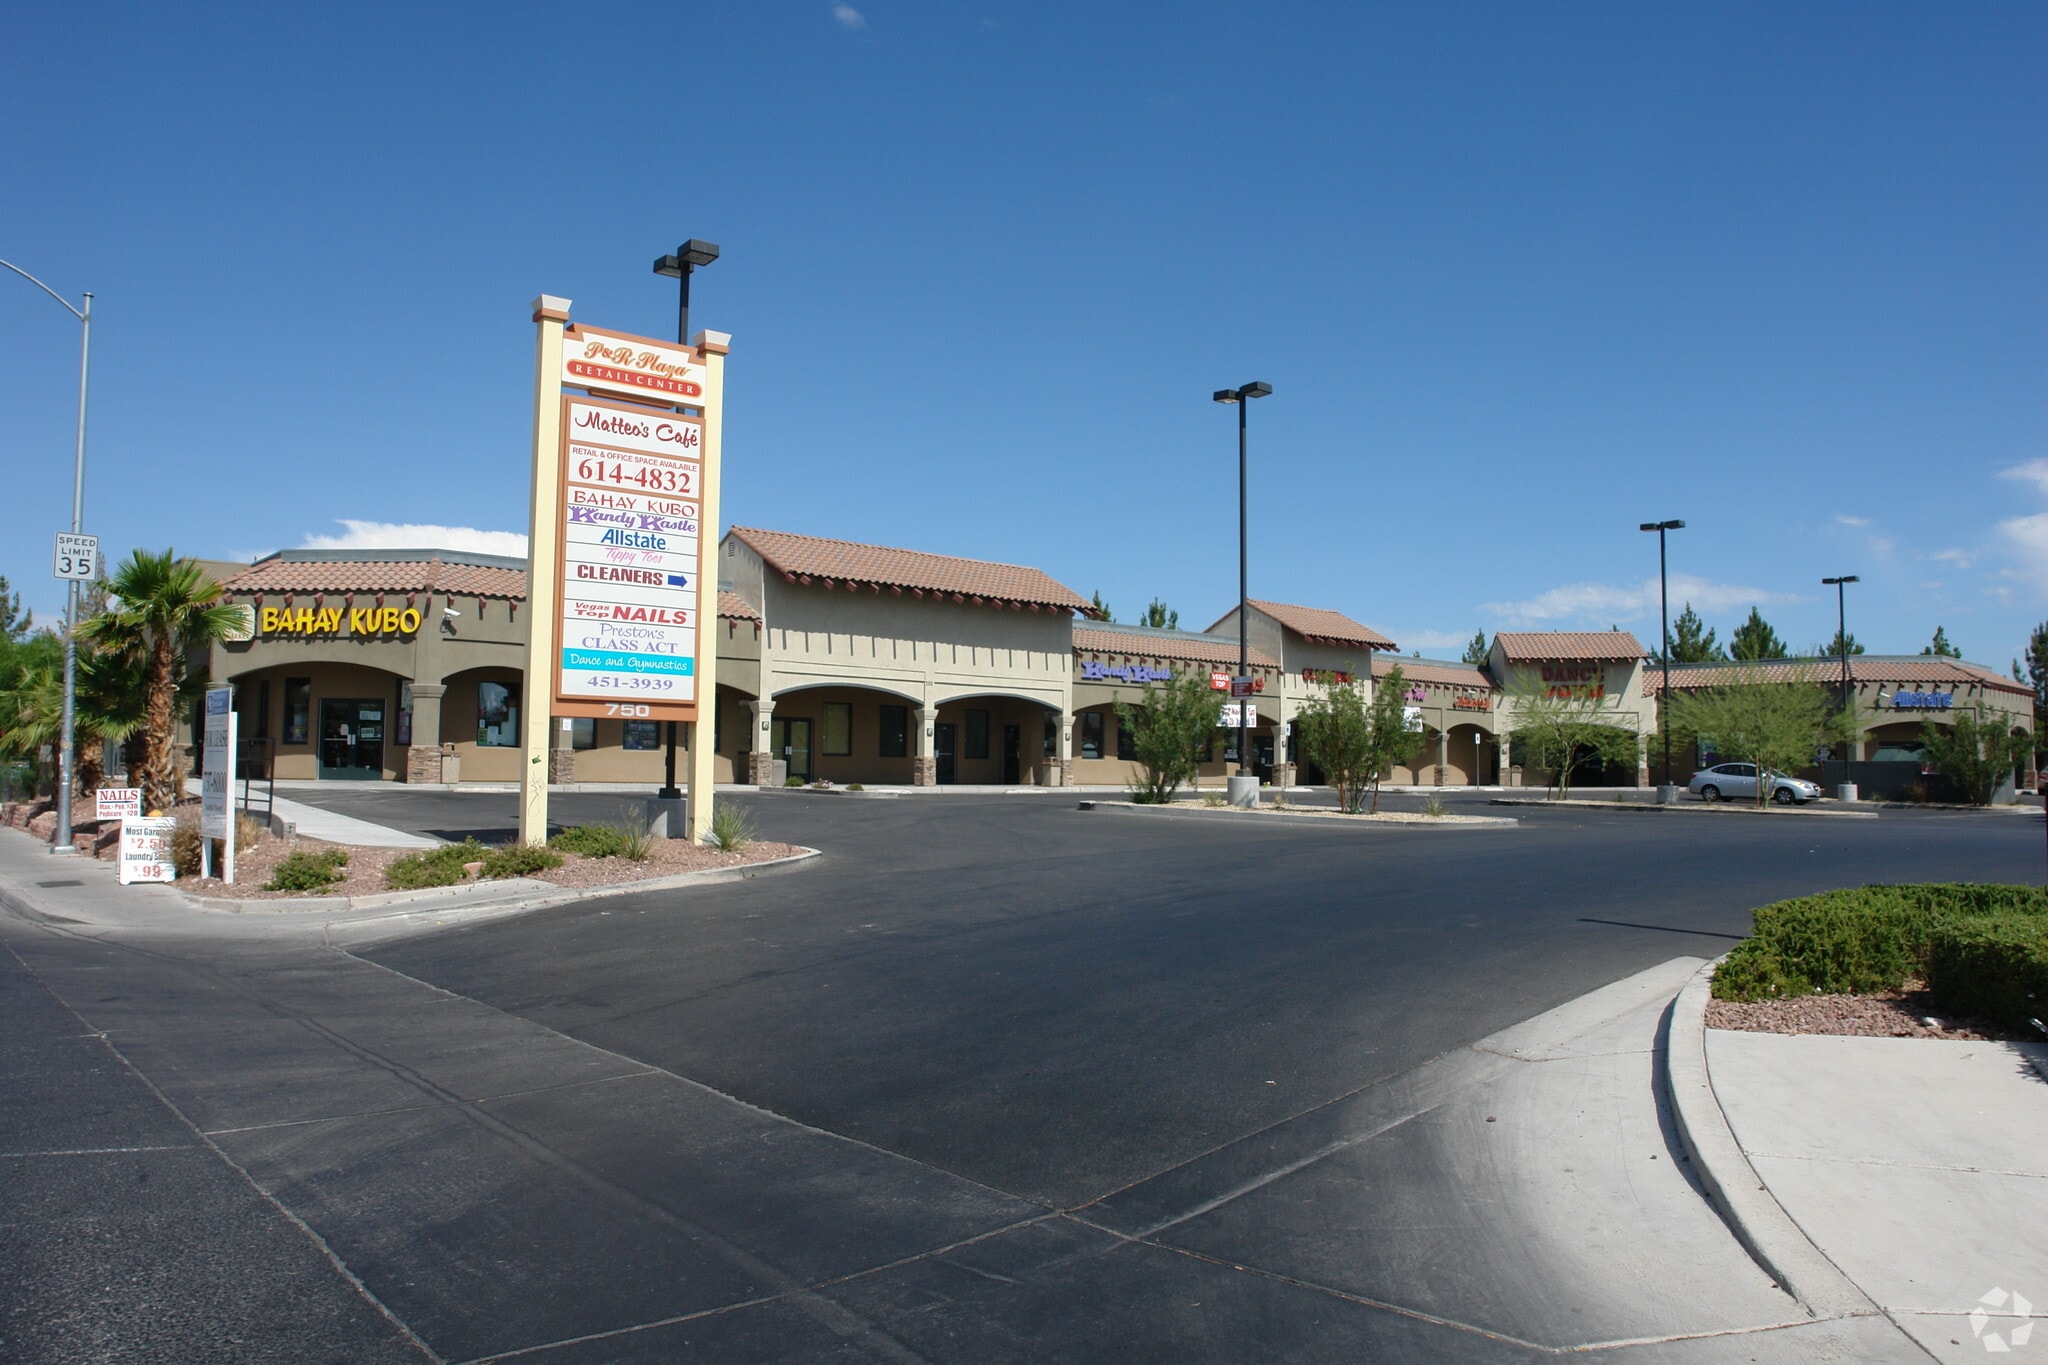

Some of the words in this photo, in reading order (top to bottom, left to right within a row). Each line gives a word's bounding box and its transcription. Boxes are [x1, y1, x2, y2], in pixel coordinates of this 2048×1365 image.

[584, 342, 635, 366] P&R
[636, 351, 691, 379] Plaza
[575, 364, 630, 382] RETAIL
[636, 375, 694, 394] CENTER
[575, 411, 649, 438] Matteo's
[656, 424, 698, 448] Café
[572, 447, 599, 458] RETAIL
[606, 452, 633, 463] OFFICE
[634, 456, 658, 467] SPACE
[659, 460, 697, 472] AVAILABLE
[578, 458, 691, 494] 614-4832
[574, 490, 637, 509] BAHAY
[648, 500, 695, 517] KUBO
[568, 505, 636, 528] Kandy
[637, 514, 697, 533] Kastle
[58, 537, 96, 547] SPEED
[600, 529, 666, 550] Allstate
[61, 547, 92, 557] LIMIT
[605, 547, 637, 566] Tippy
[641, 551, 663, 564] Toes
[58, 557, 91, 575] 35
[577, 564, 664, 586] CLEANERS
[261, 607, 345, 635] BAHAY
[350, 607, 422, 635] KUBO
[574, 609, 610, 619] Top
[575, 602, 610, 611] Vegas
[612, 606, 687, 625] NAILS
[600, 623, 665, 640] Preston's
[582, 637, 639, 651] CLASS
[645, 642, 678, 654] ACT
[570, 653, 601, 666] Dance
[605, 657, 624, 667] and
[627, 657, 688, 672] Gymnastics
[587, 676, 673, 691] 451-3939
[1890, 691, 1953, 707] Allstate
[604, 703, 650, 718] 750
[99, 790, 138, 801] NAILS
[125, 827, 142, 836] Most
[125, 852, 153, 862] Laundry
